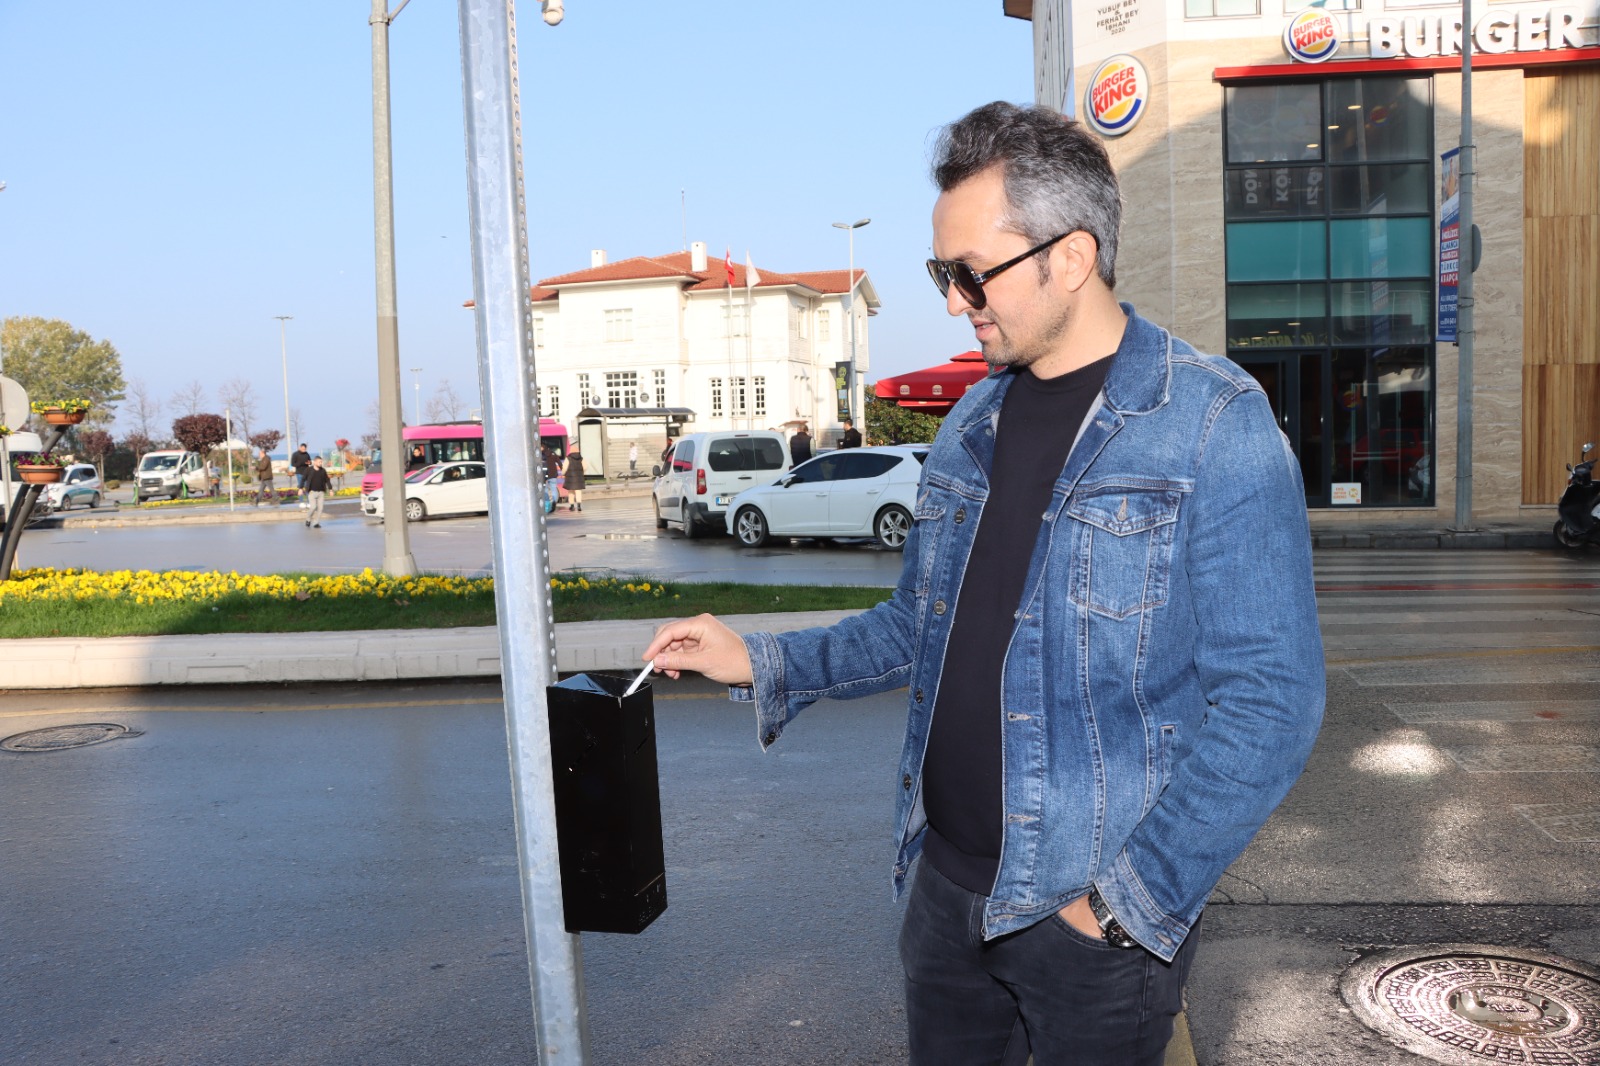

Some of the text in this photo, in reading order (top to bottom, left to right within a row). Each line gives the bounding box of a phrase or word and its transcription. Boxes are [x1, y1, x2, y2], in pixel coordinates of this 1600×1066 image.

[1096, 8, 1139, 28] FERHAT BEY
[1111, 26, 1126, 35] 2020
[1293, 16, 1331, 38] BURGER
[1296, 24, 1334, 51] KING
[1369, 6, 1585, 59] BURGER
[1093, 66, 1135, 103] BURGER
[1094, 77, 1137, 120] KING
